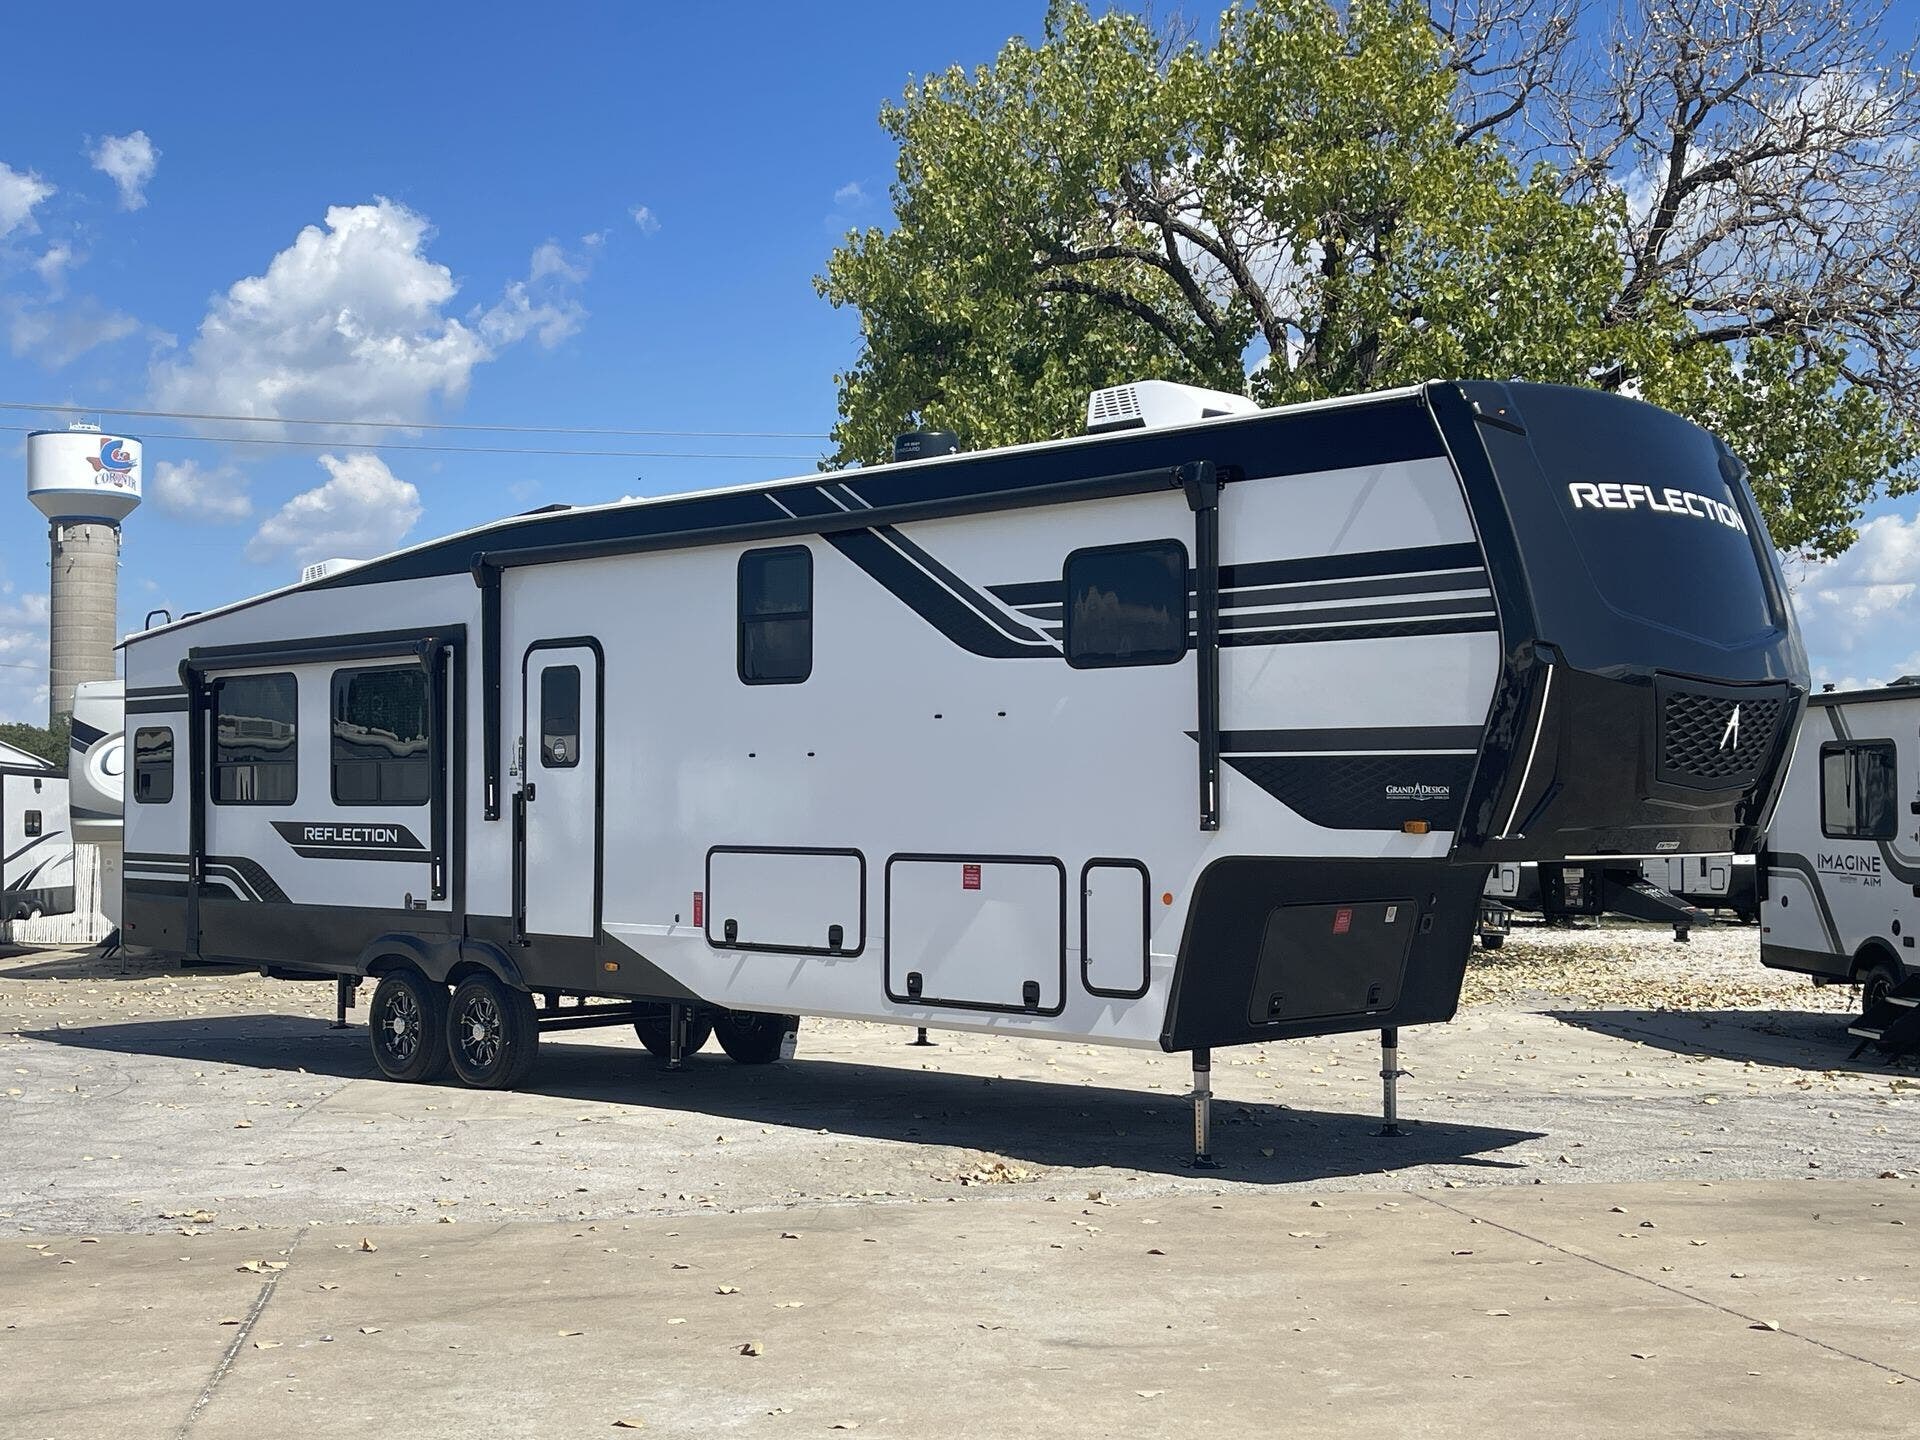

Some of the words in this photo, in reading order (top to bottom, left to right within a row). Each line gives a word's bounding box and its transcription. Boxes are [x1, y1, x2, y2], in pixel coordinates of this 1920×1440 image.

[1569, 482, 1748, 536] REFLECTION
[1386, 785, 1414, 793] GRAND
[1421, 785, 1450, 793] DESIGN
[304, 827, 398, 842] REFLECTION
[1817, 853, 1881, 872] IMAGINE
[1863, 878, 1882, 887] AIM
